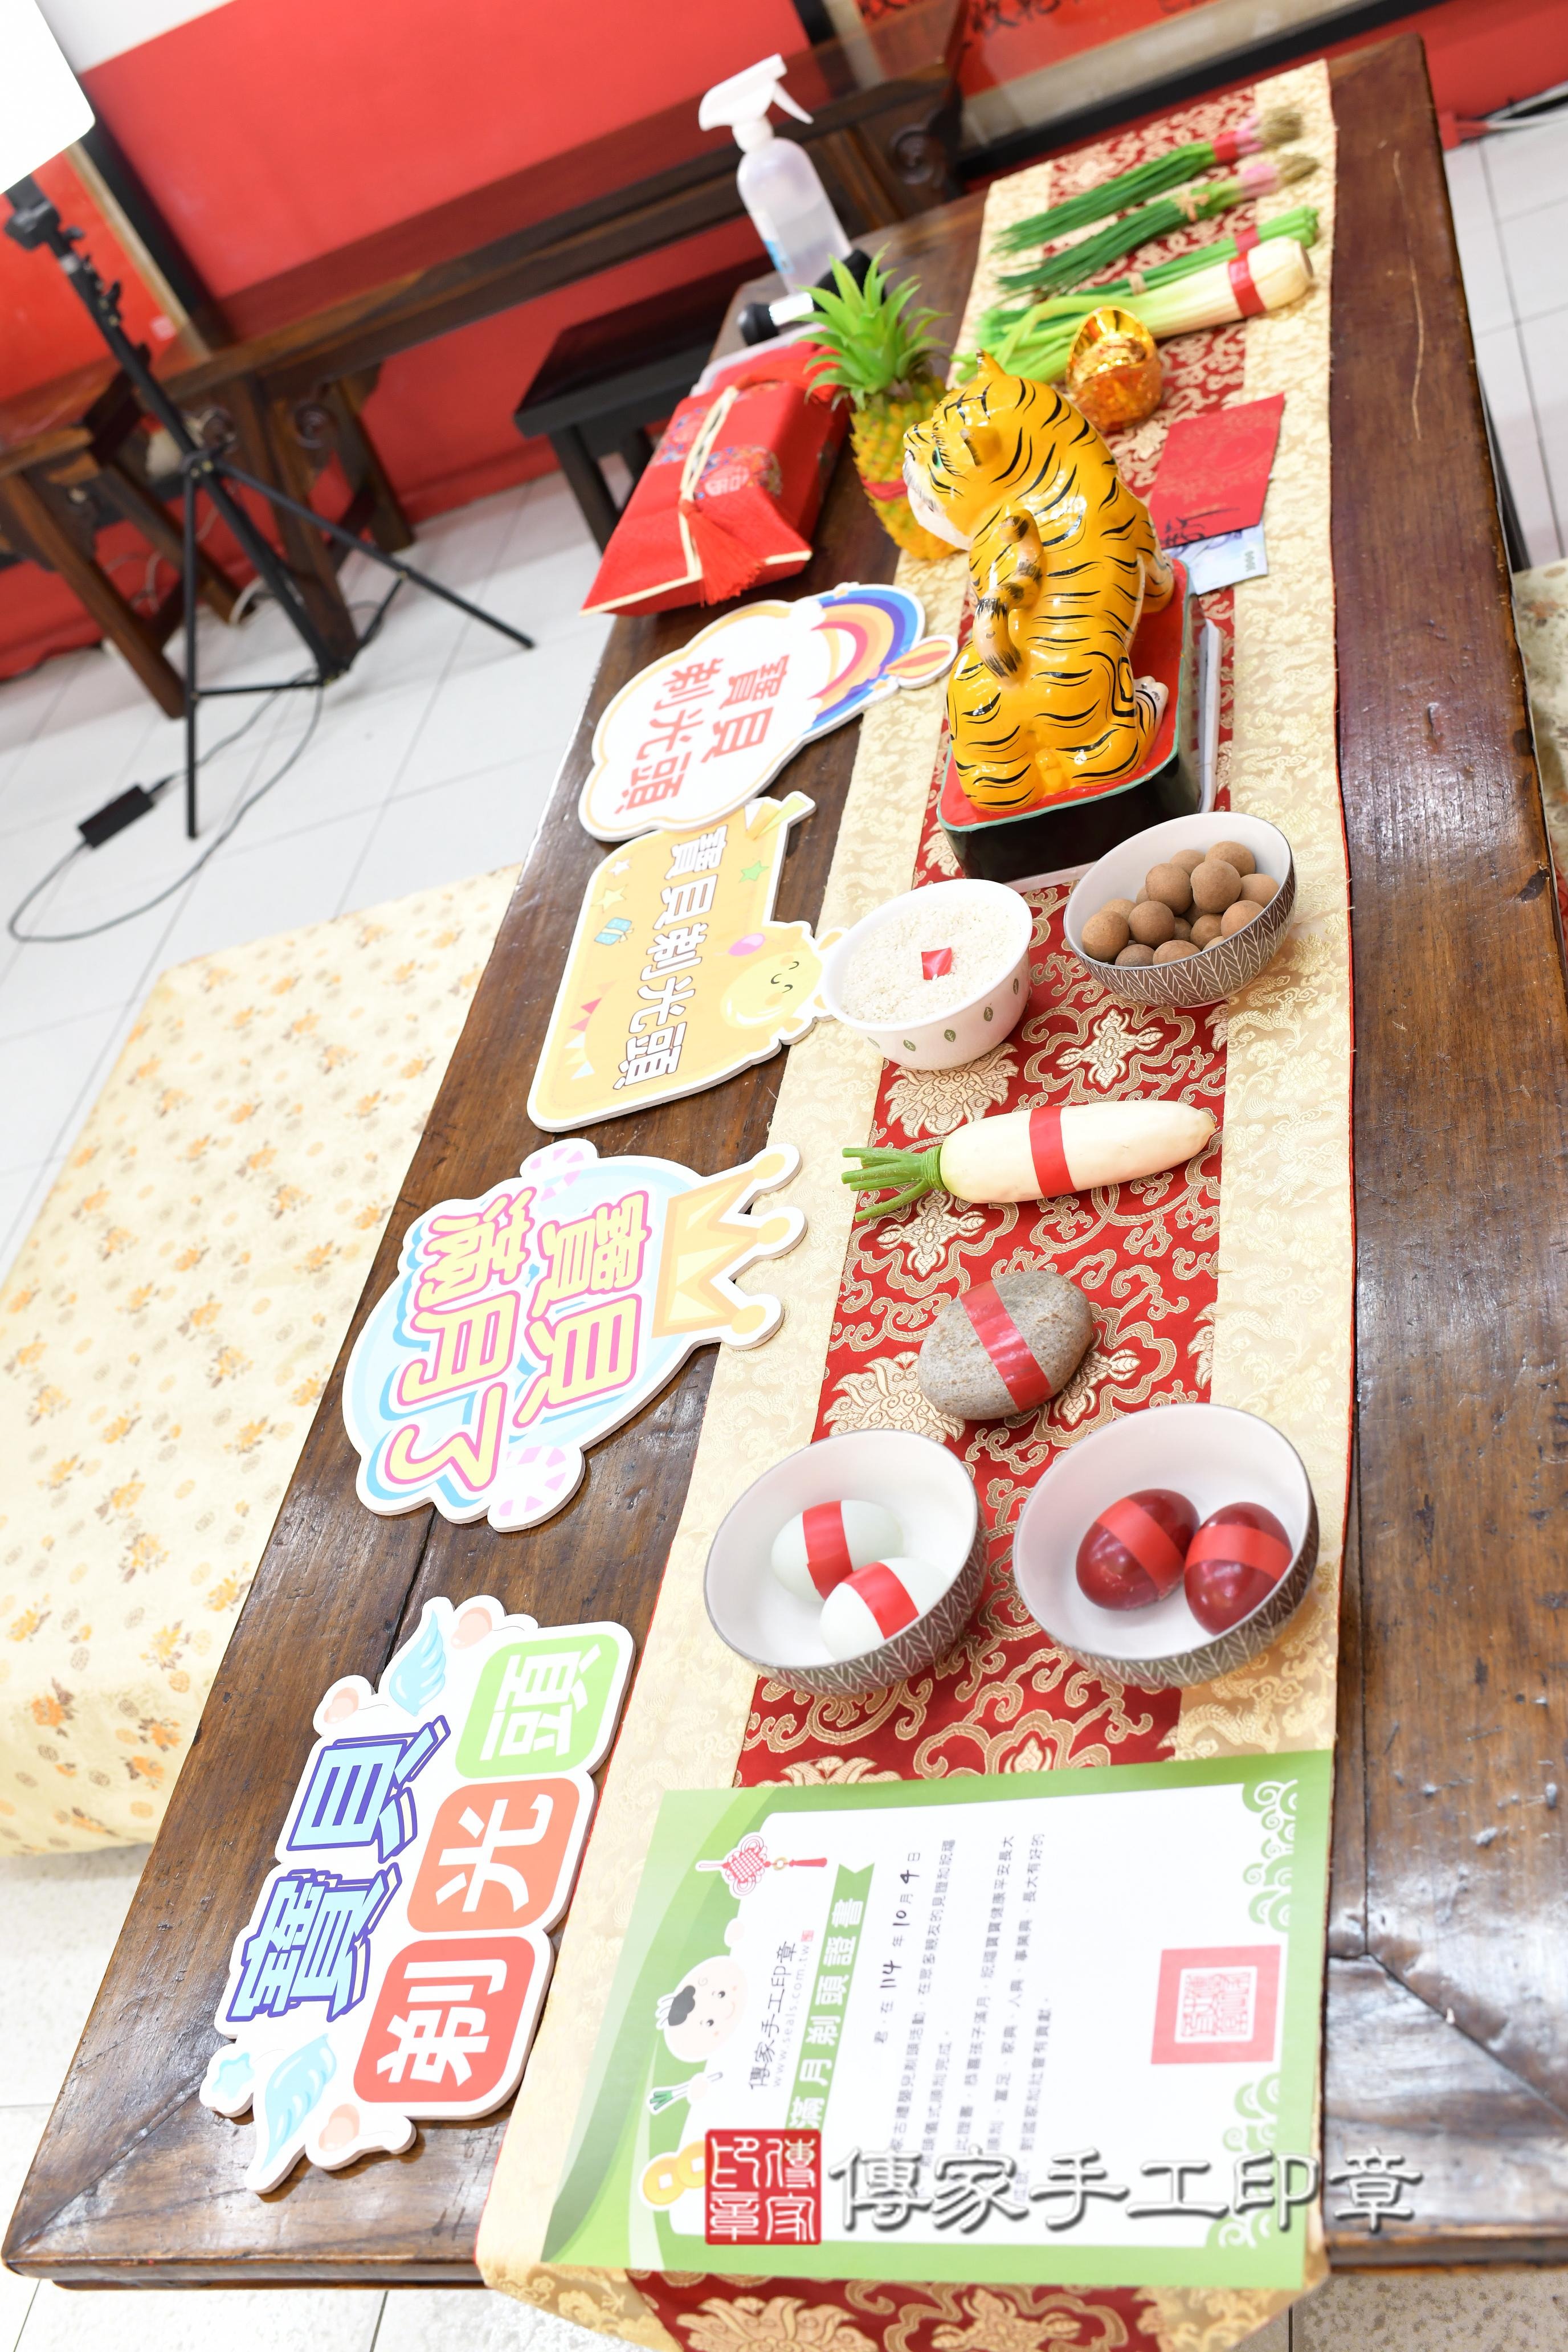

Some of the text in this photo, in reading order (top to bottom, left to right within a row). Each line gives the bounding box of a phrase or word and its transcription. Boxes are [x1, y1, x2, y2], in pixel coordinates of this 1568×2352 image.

[614, 658, 724, 815] 剃光頭
[701, 654, 790, 763] 寶貝
[612, 824, 728, 1091] 寶貝剃光頭
[385, 1186, 537, 1492] 滿月了
[512, 1190, 652, 1428] 寶貝
[226, 1715, 451, 2023] 寶貝
[377, 1644, 600, 2086] 剃光頭
[893, 1910, 911, 1927] 10
[900, 1869, 920, 1884] 4
[900, 1893, 914, 1904] 月
[908, 1852, 921, 1863] 日
[789, 1897, 864, 2130] 滿月剃頭證書
[880, 1959, 902, 1989] 114
[892, 1935, 904, 1947] 年
[749, 1941, 798, 2090] 傳家手工印章
[773, 1943, 810, 2088] www.seals.com.tw
